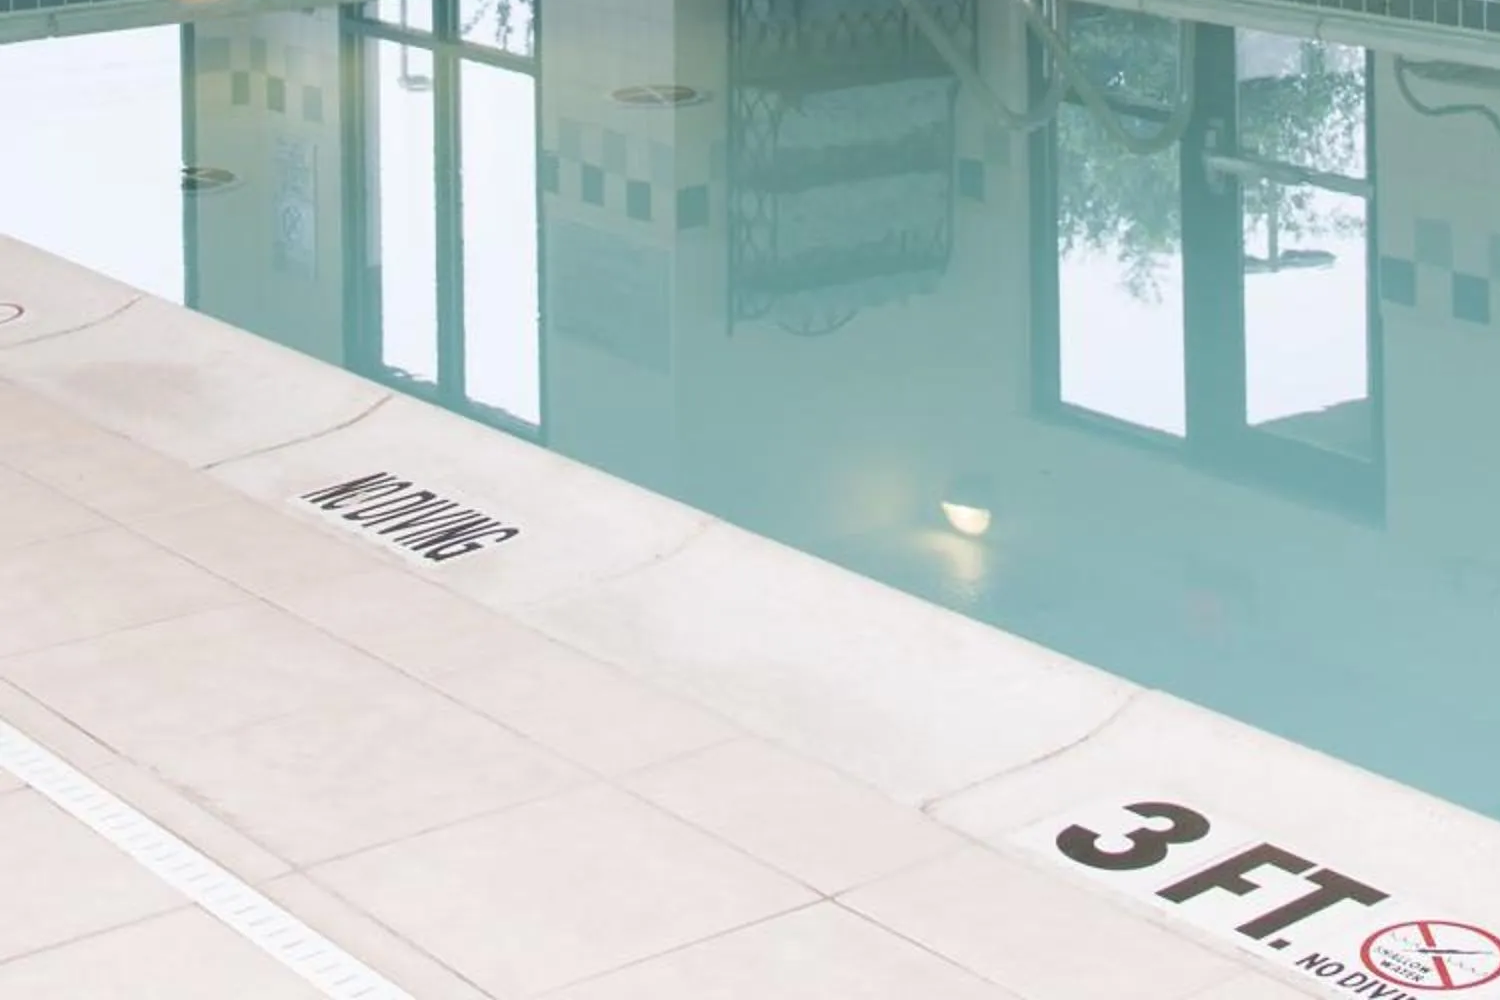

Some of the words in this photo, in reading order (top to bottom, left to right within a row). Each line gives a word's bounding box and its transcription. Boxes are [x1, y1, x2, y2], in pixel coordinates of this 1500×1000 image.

[341, 490, 520, 562] DIVING
[1056, 801, 1211, 871] 3
[1154, 842, 1392, 950] FT.
[1295, 952, 1345, 977] NO
[1336, 971, 1418, 1000] DIVI
